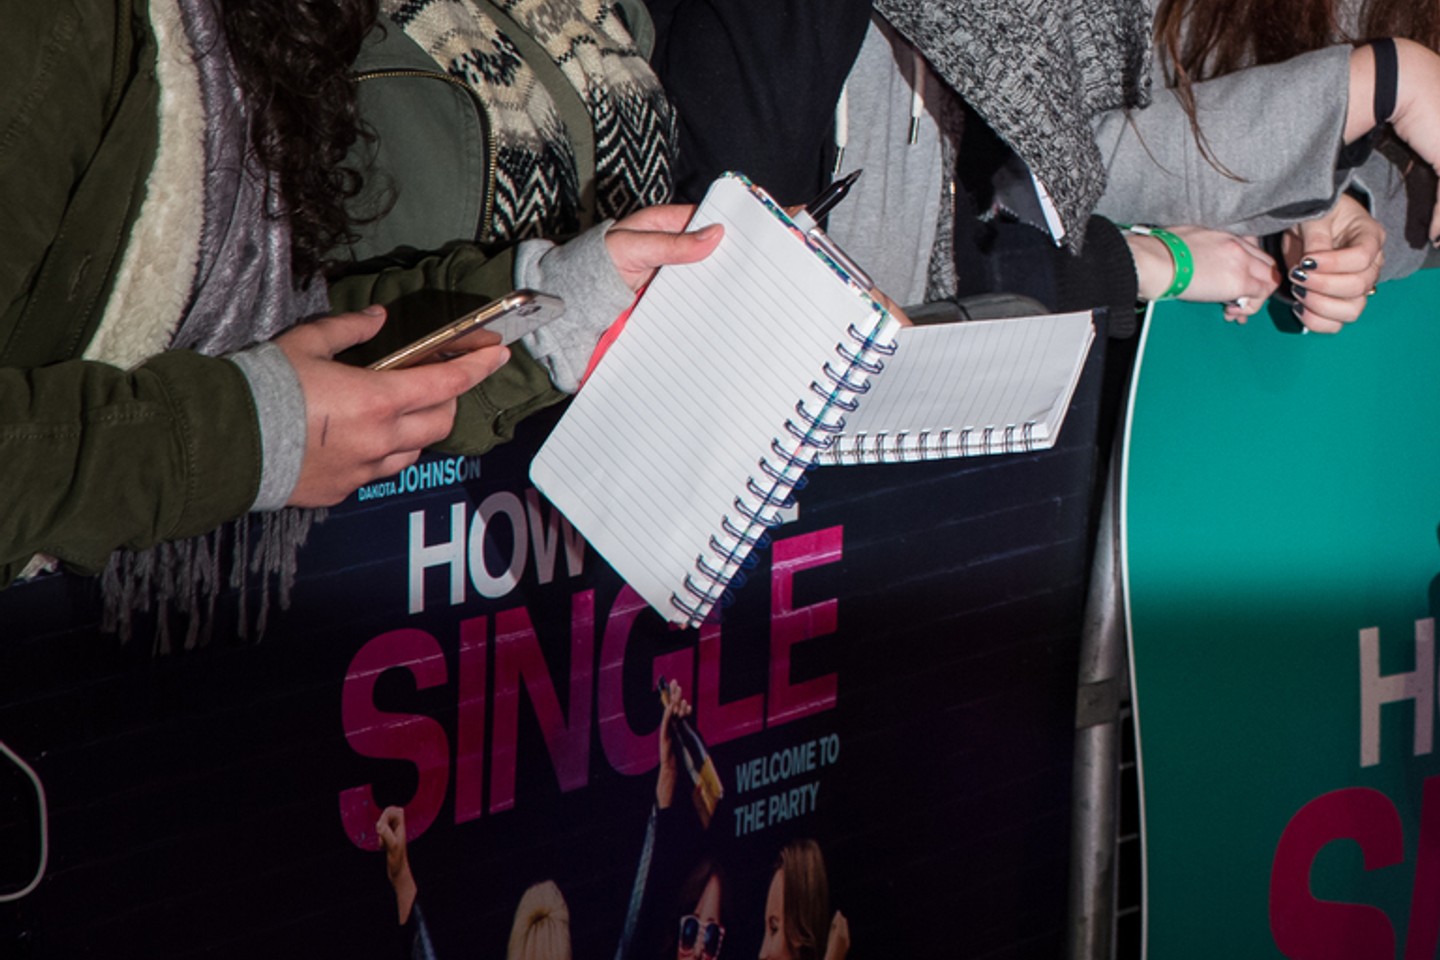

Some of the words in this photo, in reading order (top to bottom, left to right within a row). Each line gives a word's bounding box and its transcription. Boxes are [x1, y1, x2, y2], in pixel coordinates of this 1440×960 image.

[357, 481, 397, 502] DAKOTA
[397, 455, 480, 494] JOHNSON
[338, 524, 844, 852] SINGLE
[735, 740, 817, 794] WELCOME
[818, 732, 840, 768] TO
[733, 798, 766, 838] THE
[767, 780, 820, 827] PARTY
